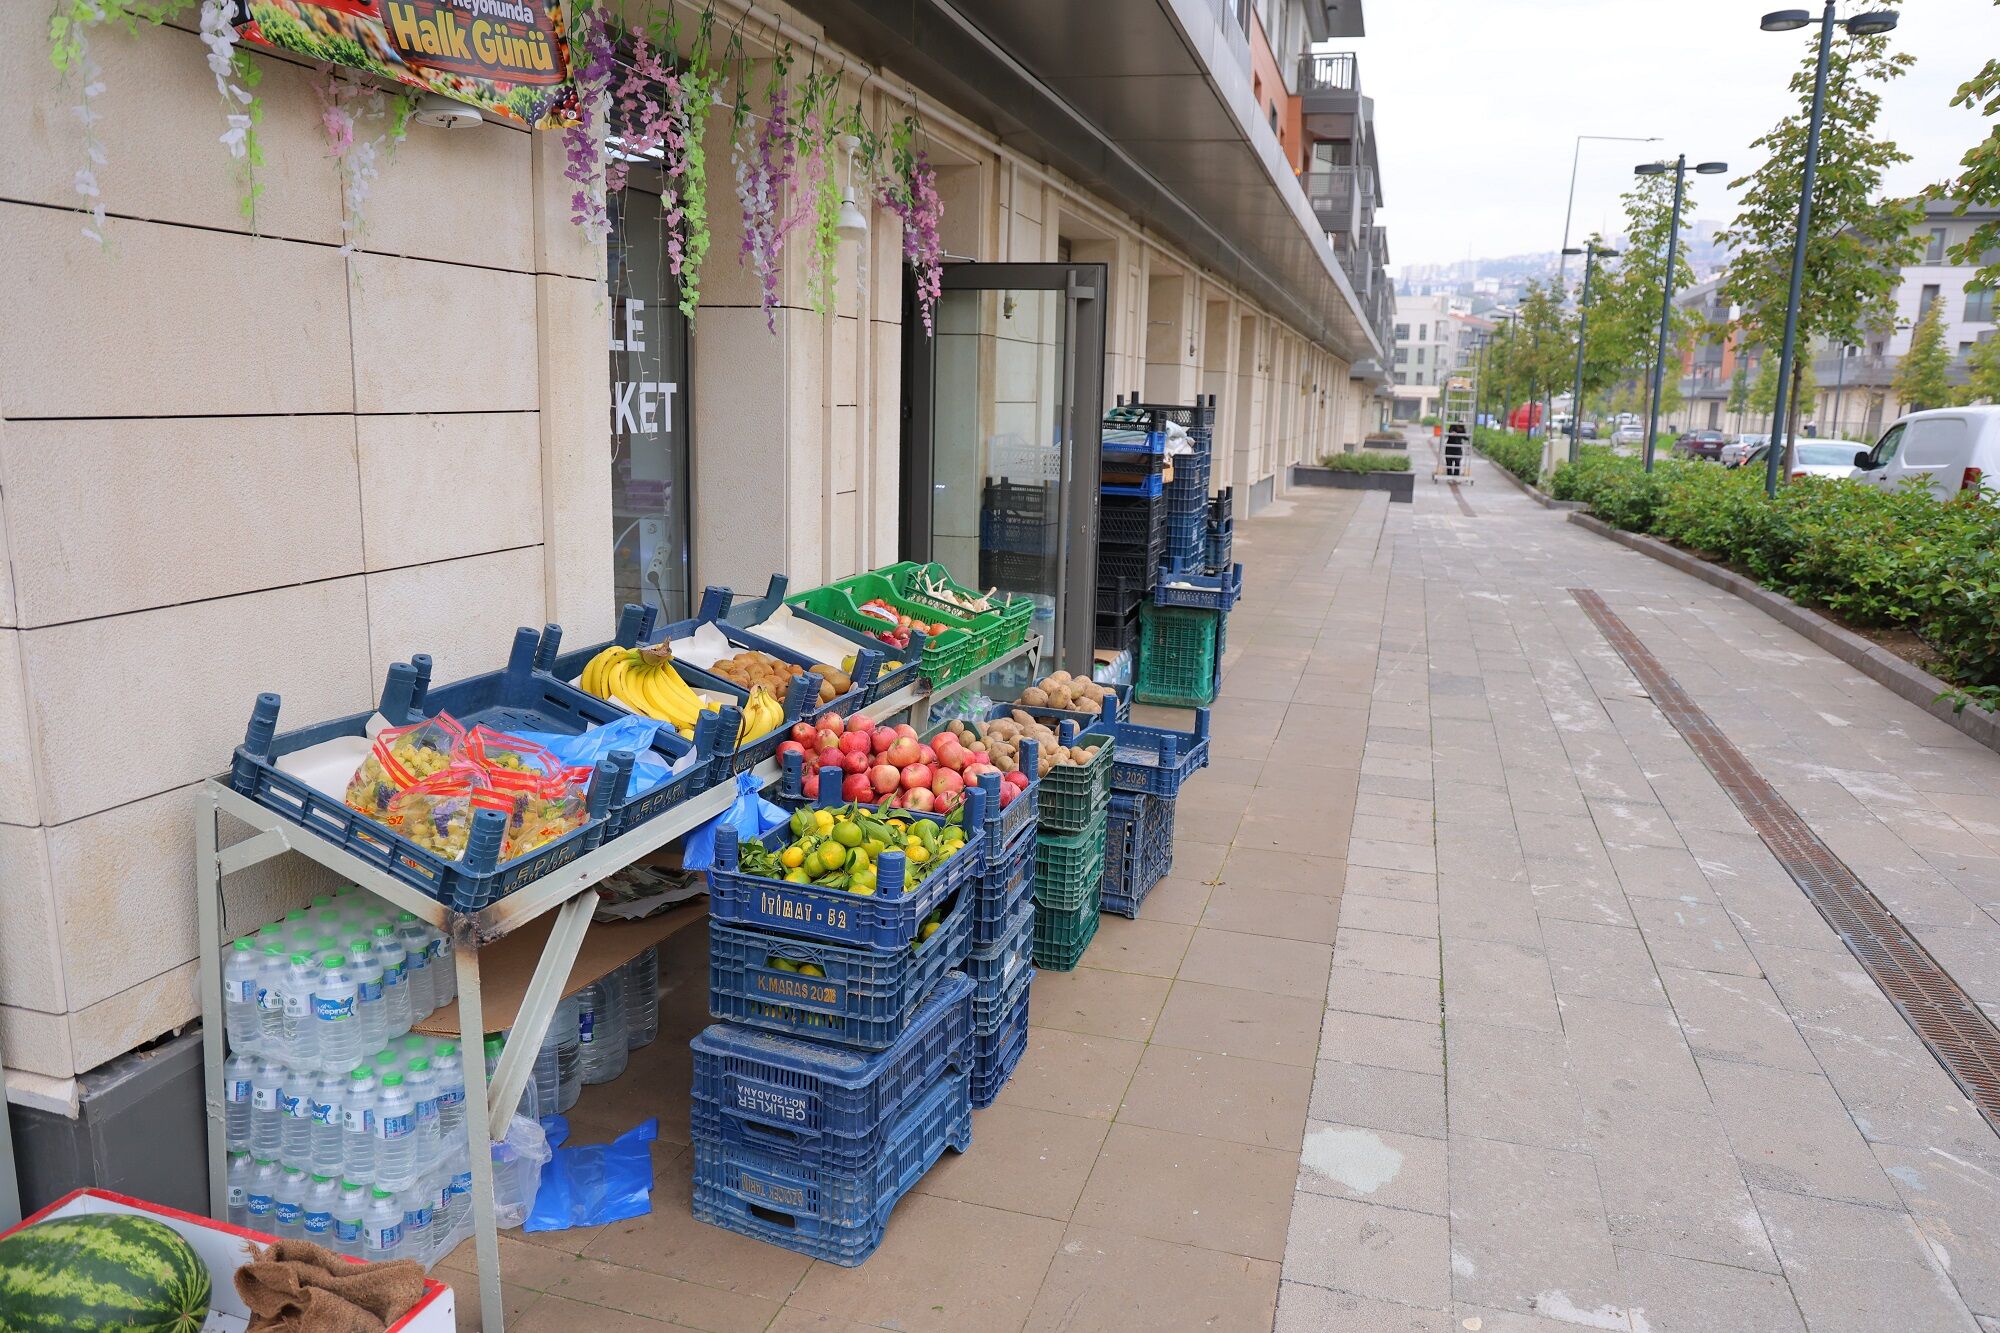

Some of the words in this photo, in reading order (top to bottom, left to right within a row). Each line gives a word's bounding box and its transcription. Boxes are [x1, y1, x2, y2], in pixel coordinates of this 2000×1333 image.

[453, 0, 534, 24] eyonunda
[389, 2, 472, 60] Halk
[472, 19, 554, 71] Günü
[614, 382, 677, 435] KET
[827, 908, 847, 928] 52
